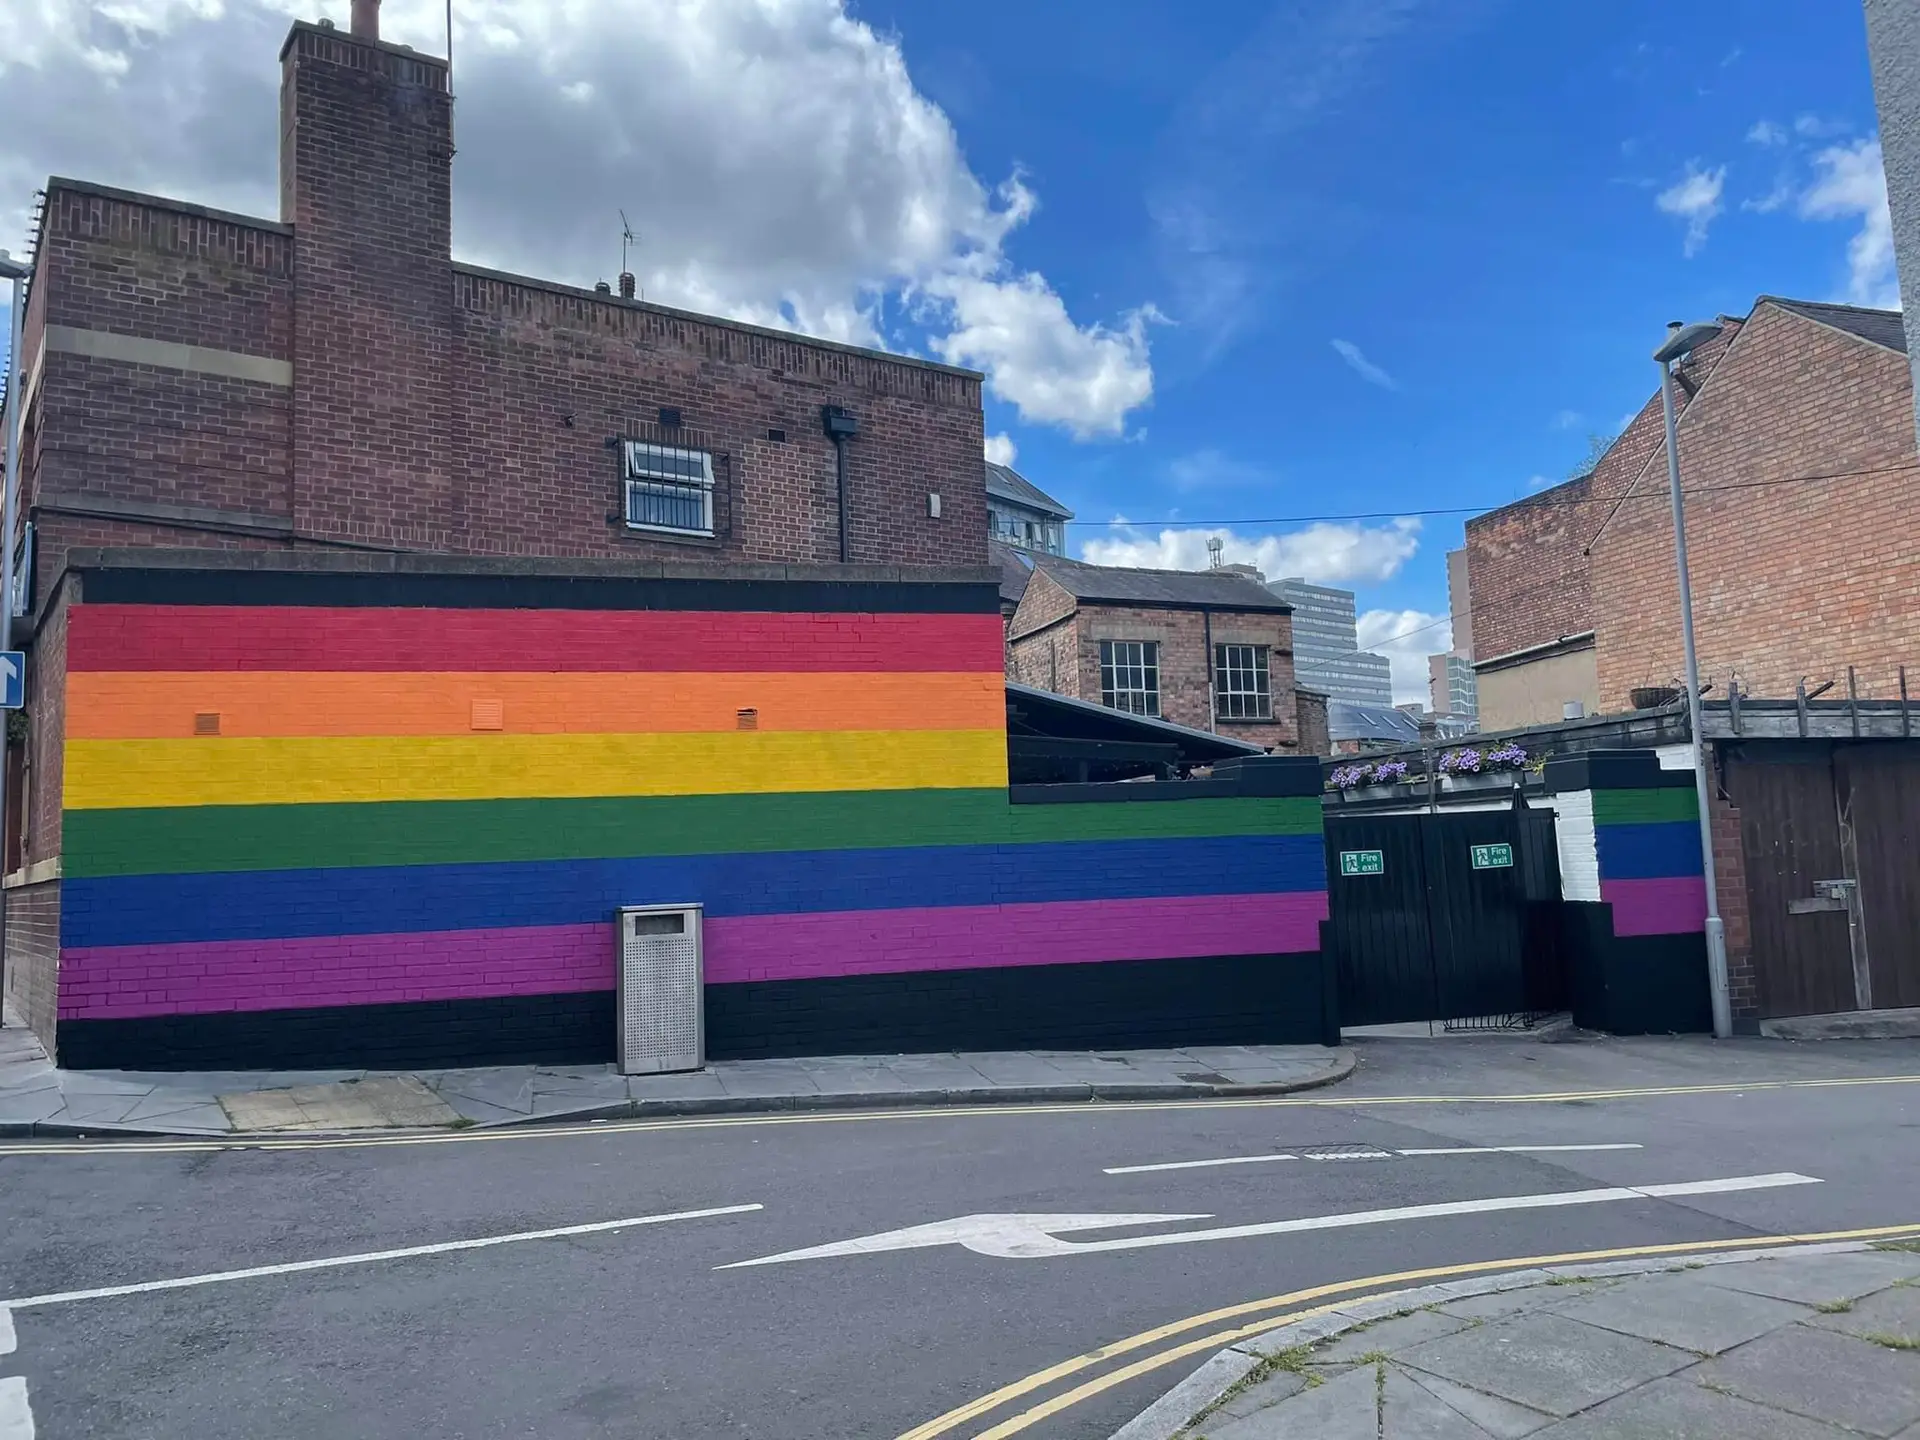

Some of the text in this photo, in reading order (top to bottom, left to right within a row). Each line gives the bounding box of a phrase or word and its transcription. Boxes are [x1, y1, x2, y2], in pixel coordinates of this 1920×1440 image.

[1491, 847, 1507, 855] Fire
[1361, 853, 1378, 862] Fire
[1492, 856, 1508, 865] exit
[1362, 863, 1379, 872] exit
